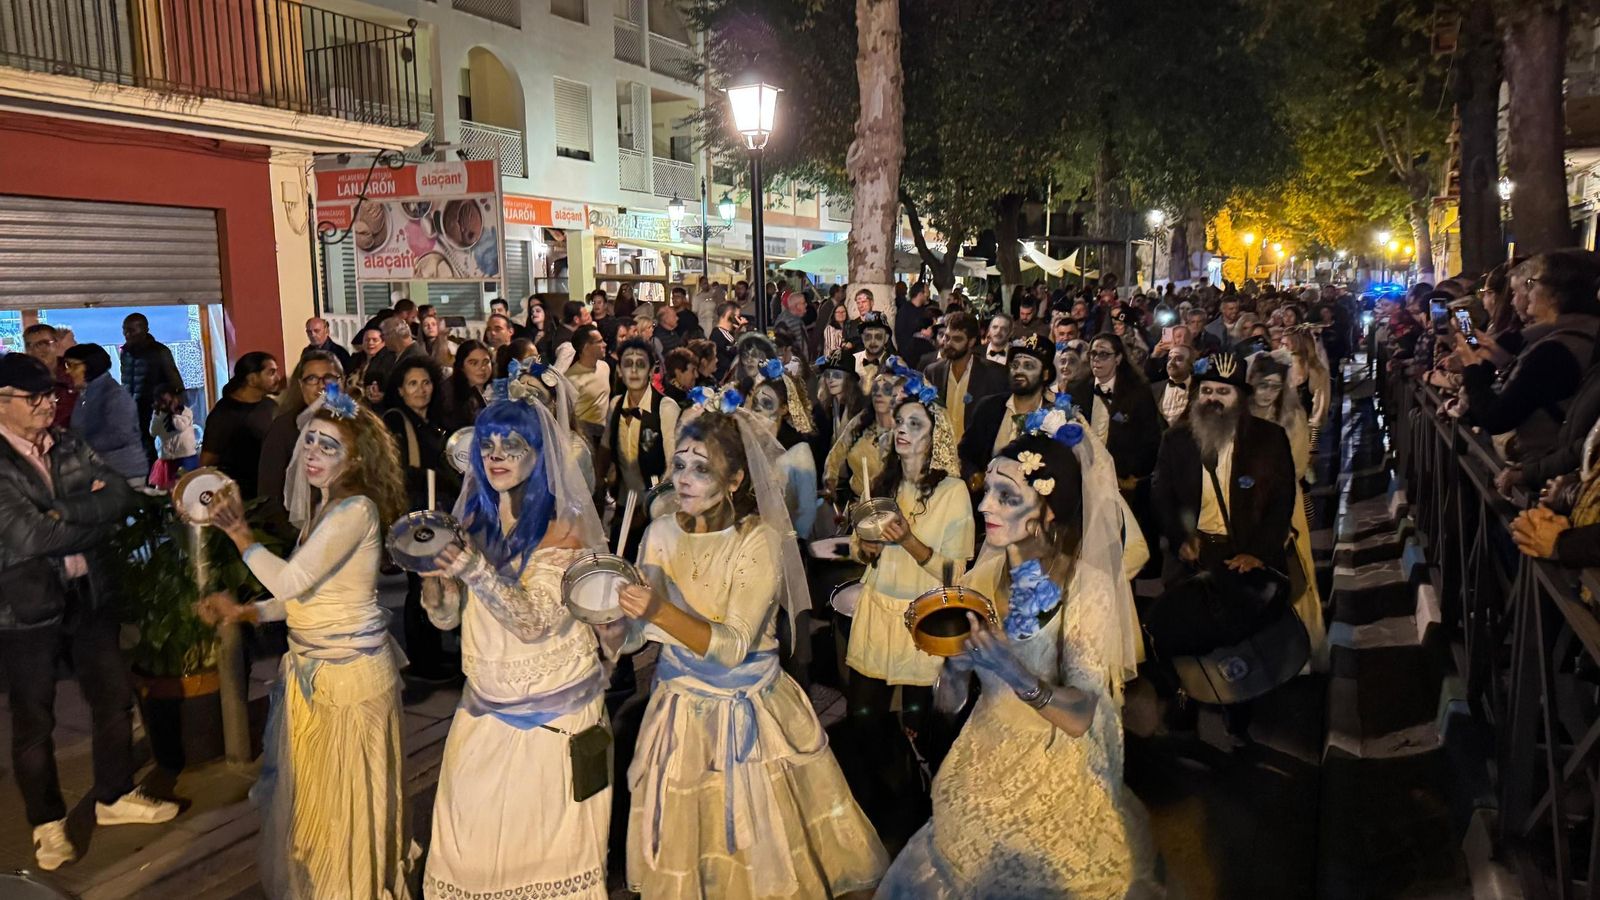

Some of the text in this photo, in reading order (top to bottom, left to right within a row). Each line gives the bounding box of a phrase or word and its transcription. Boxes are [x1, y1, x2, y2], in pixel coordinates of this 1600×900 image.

[337, 178, 396, 197] LANJARÓN
[421, 172, 462, 188] alaçant
[503, 207, 536, 222] NJARÓN
[554, 209, 583, 224] alaçant
[364, 253, 416, 273] alaçant
